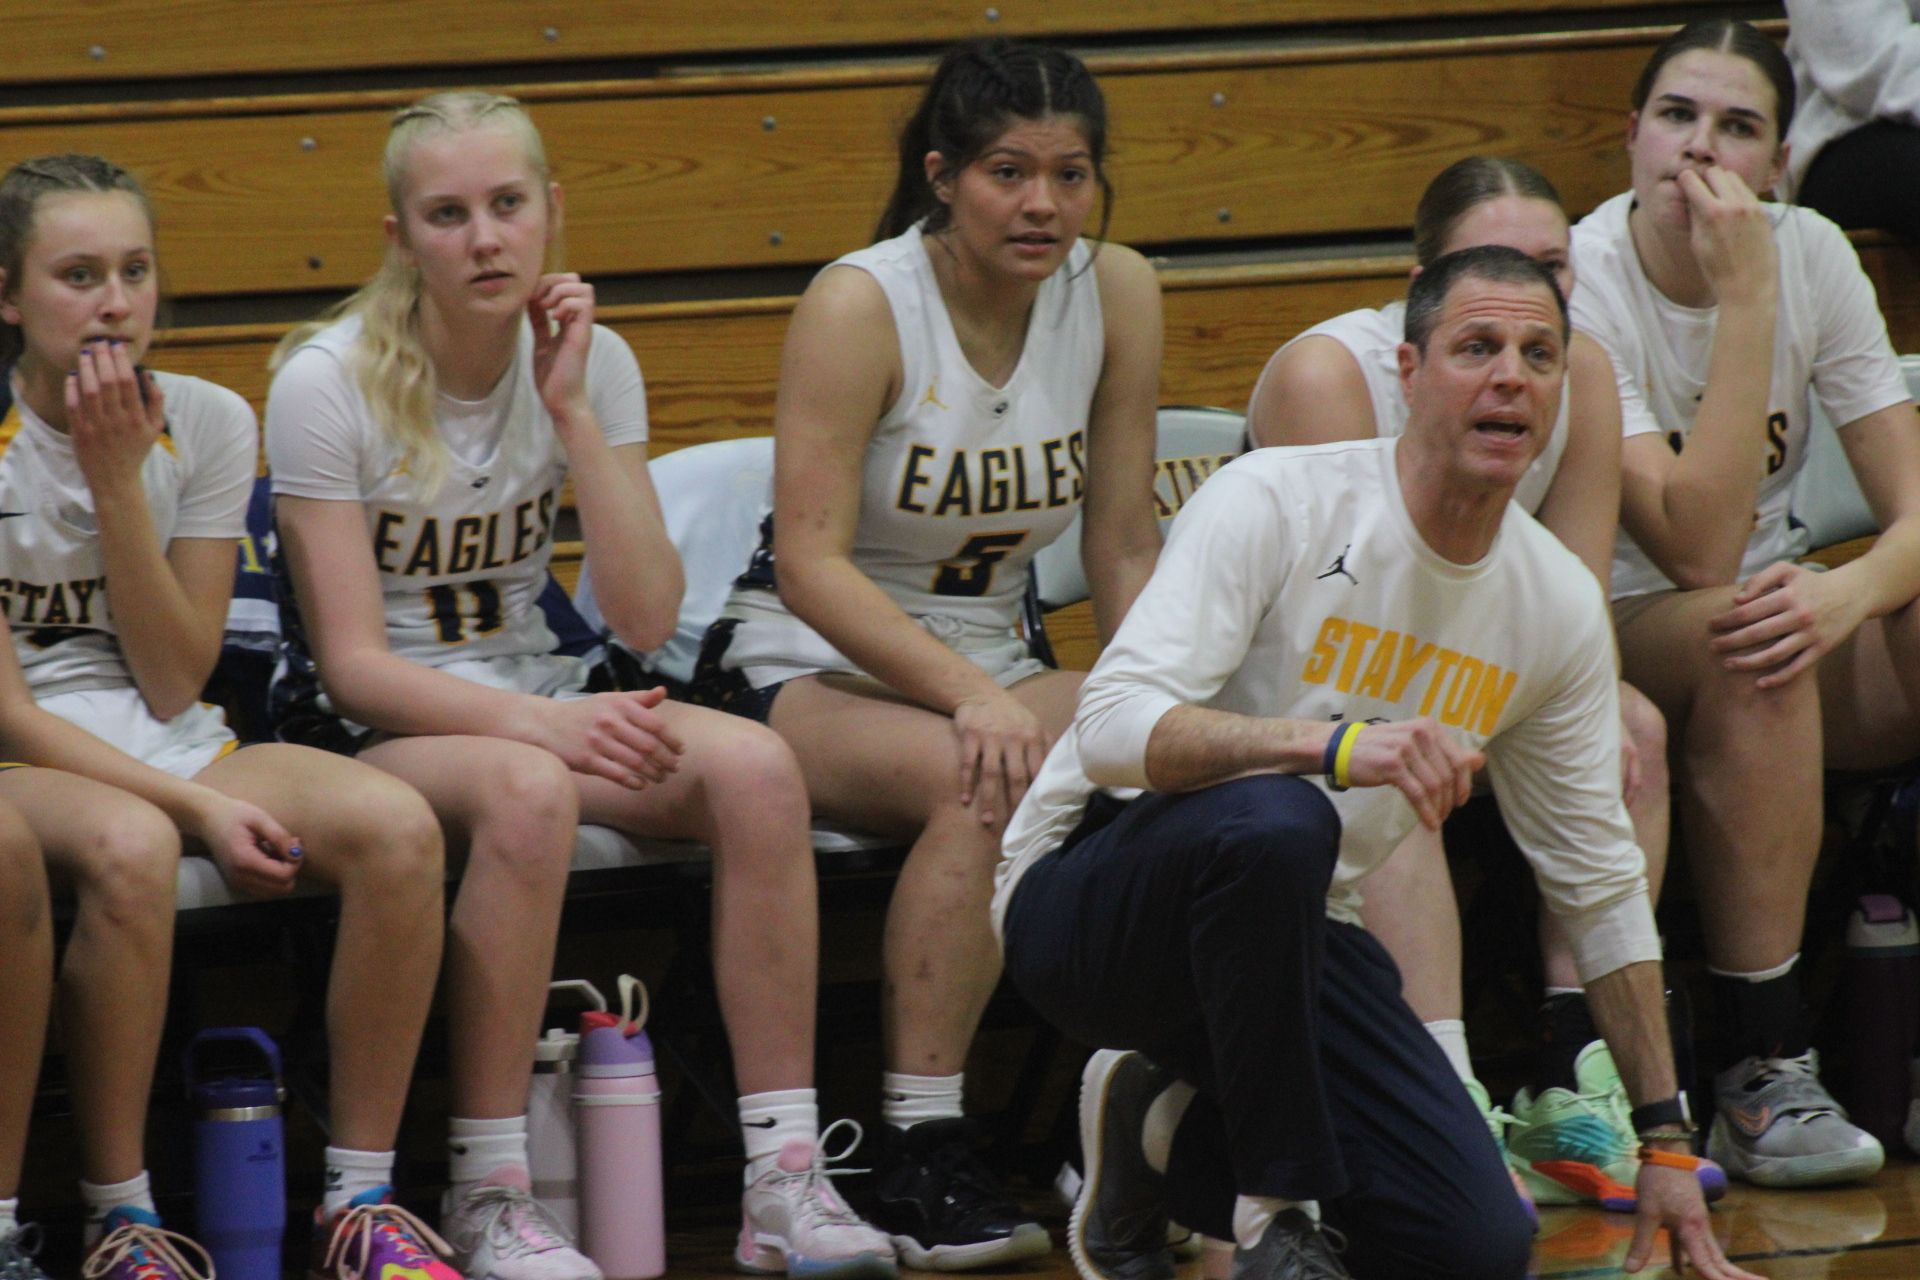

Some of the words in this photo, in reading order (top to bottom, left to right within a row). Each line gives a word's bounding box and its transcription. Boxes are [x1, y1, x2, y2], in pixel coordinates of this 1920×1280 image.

[897, 429, 1084, 516] EAGLES
[374, 488, 554, 576] EAGLES
[931, 529, 1030, 596] 5
[0, 576, 107, 624] STAY
[1302, 616, 1518, 737] STAYTON
